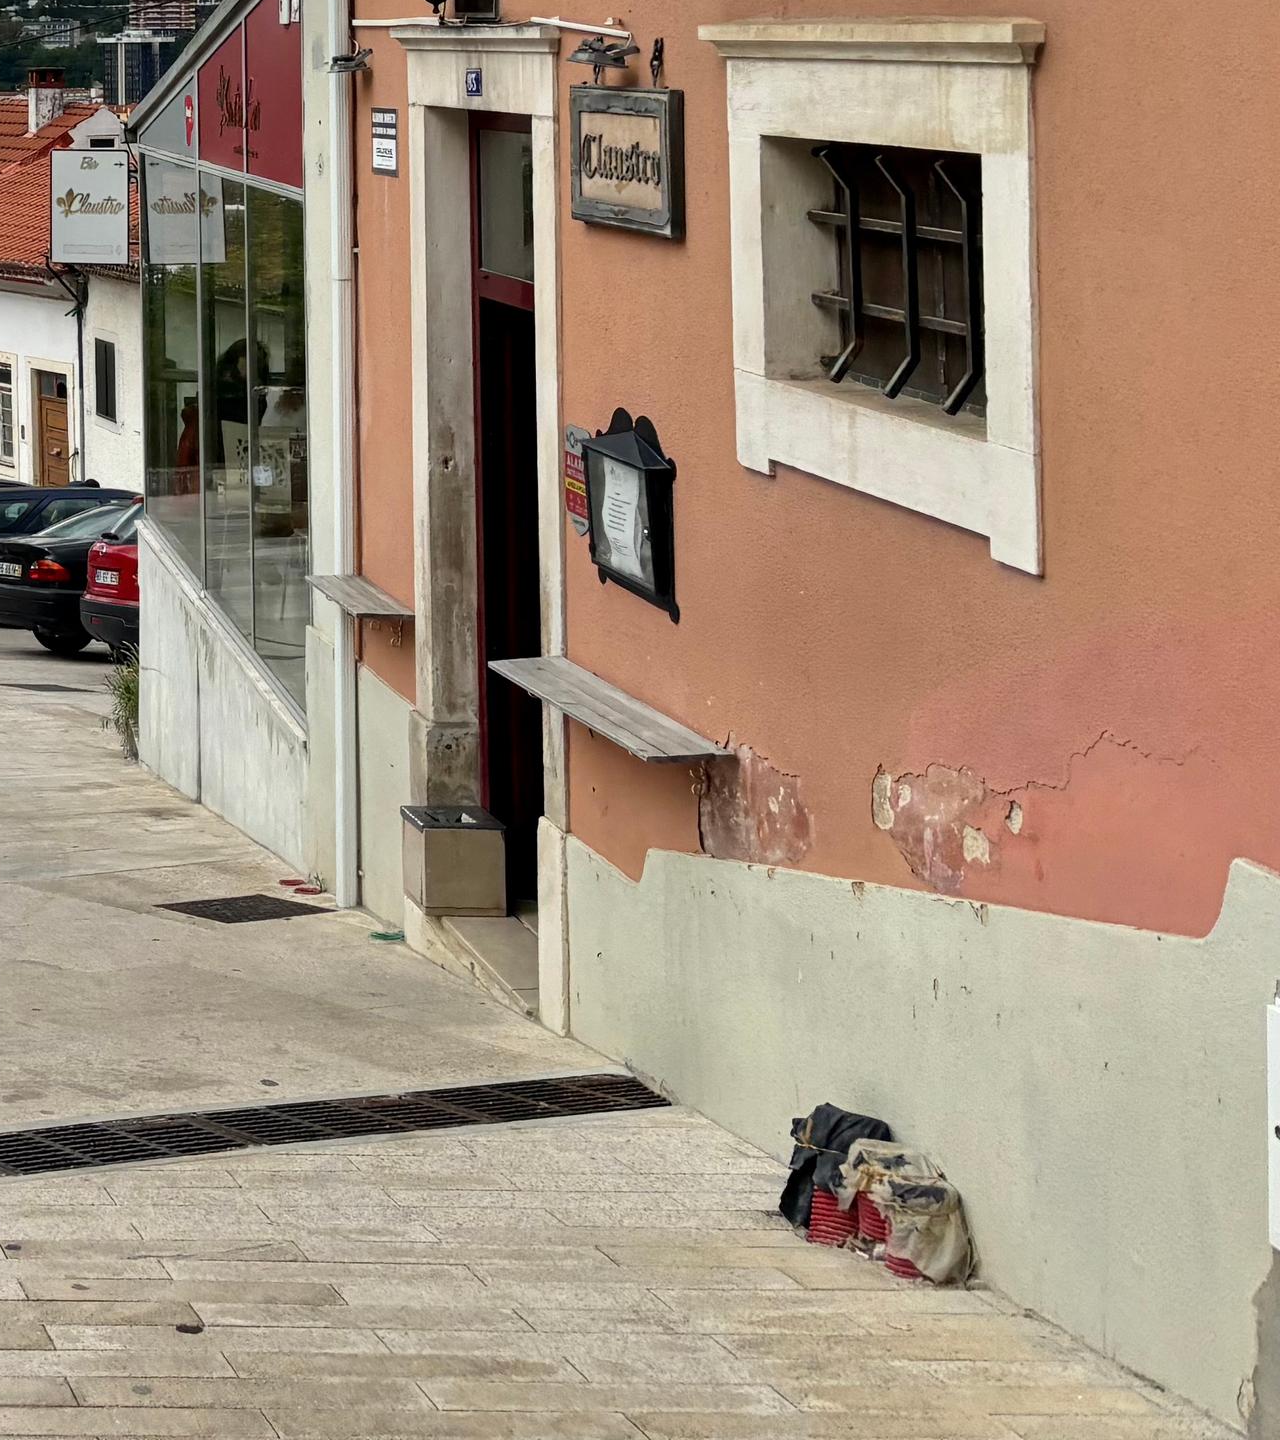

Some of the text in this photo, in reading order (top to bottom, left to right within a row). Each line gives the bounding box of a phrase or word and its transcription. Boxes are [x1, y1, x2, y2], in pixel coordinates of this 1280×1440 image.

[80, 156, 100, 170] Bar
[582, 133, 662, 186] Claustro
[69, 192, 125, 215] Claustro
